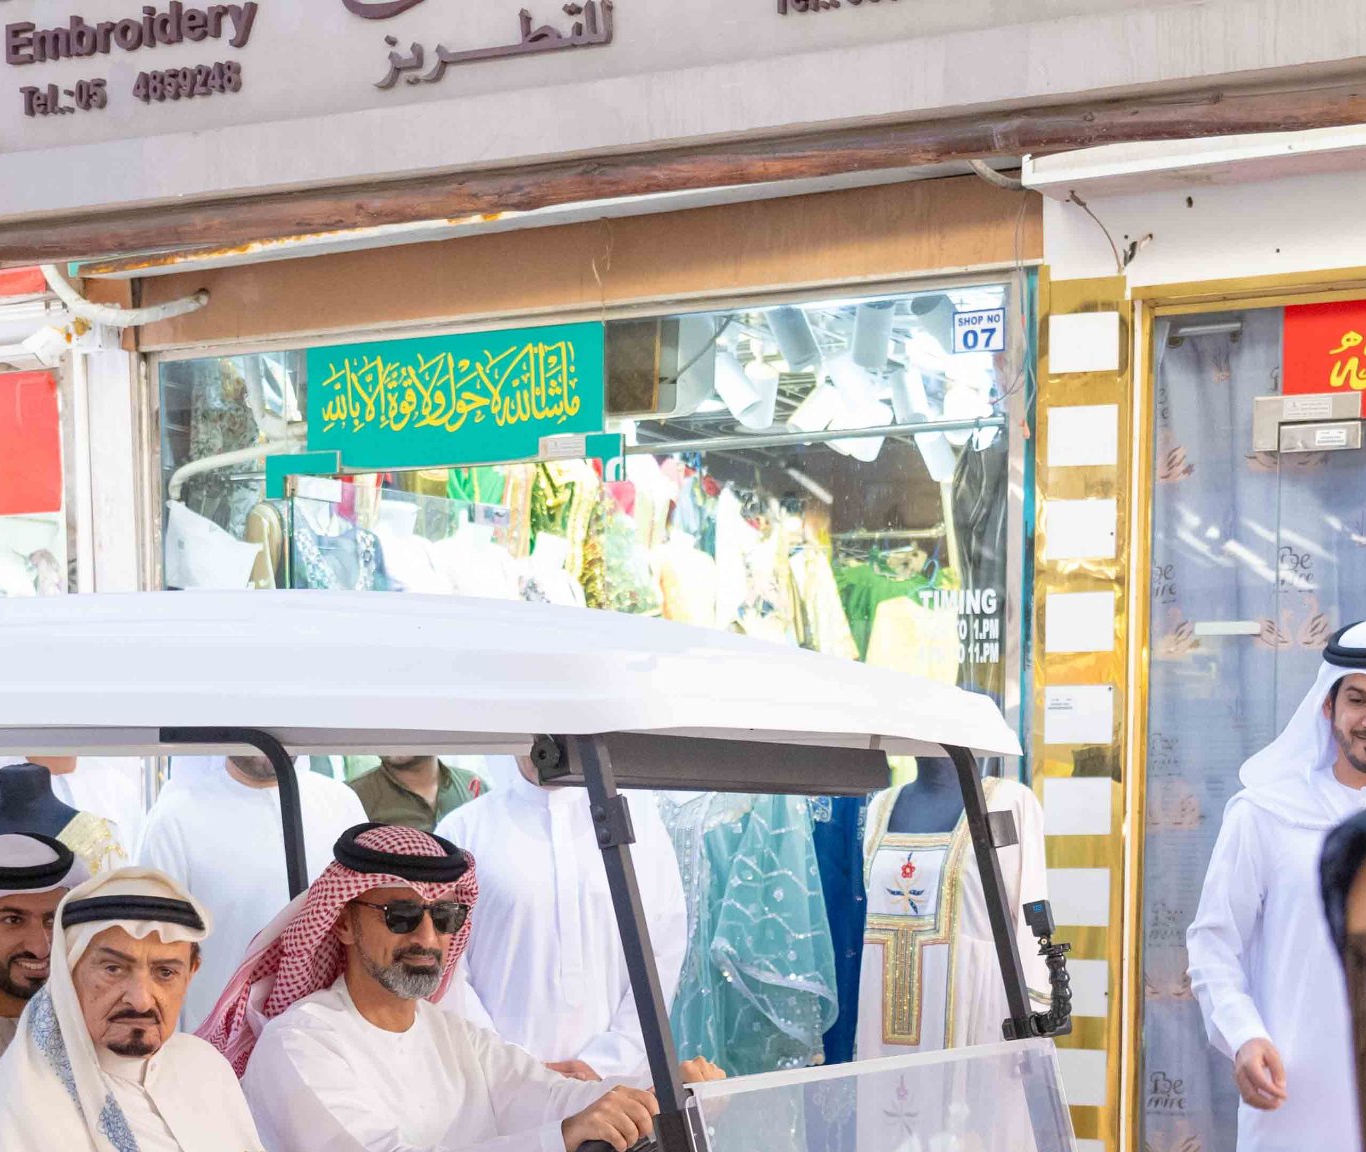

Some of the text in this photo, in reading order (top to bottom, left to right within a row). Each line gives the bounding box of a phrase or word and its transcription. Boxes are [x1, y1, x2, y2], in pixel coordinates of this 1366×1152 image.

[5, 0, 258, 65] Embroidery
[133, 60, 242, 104] 4859248
[958, 313, 1001, 327] SHOP NO
[962, 327, 997, 350] 07
[918, 588, 998, 615] TIMING
